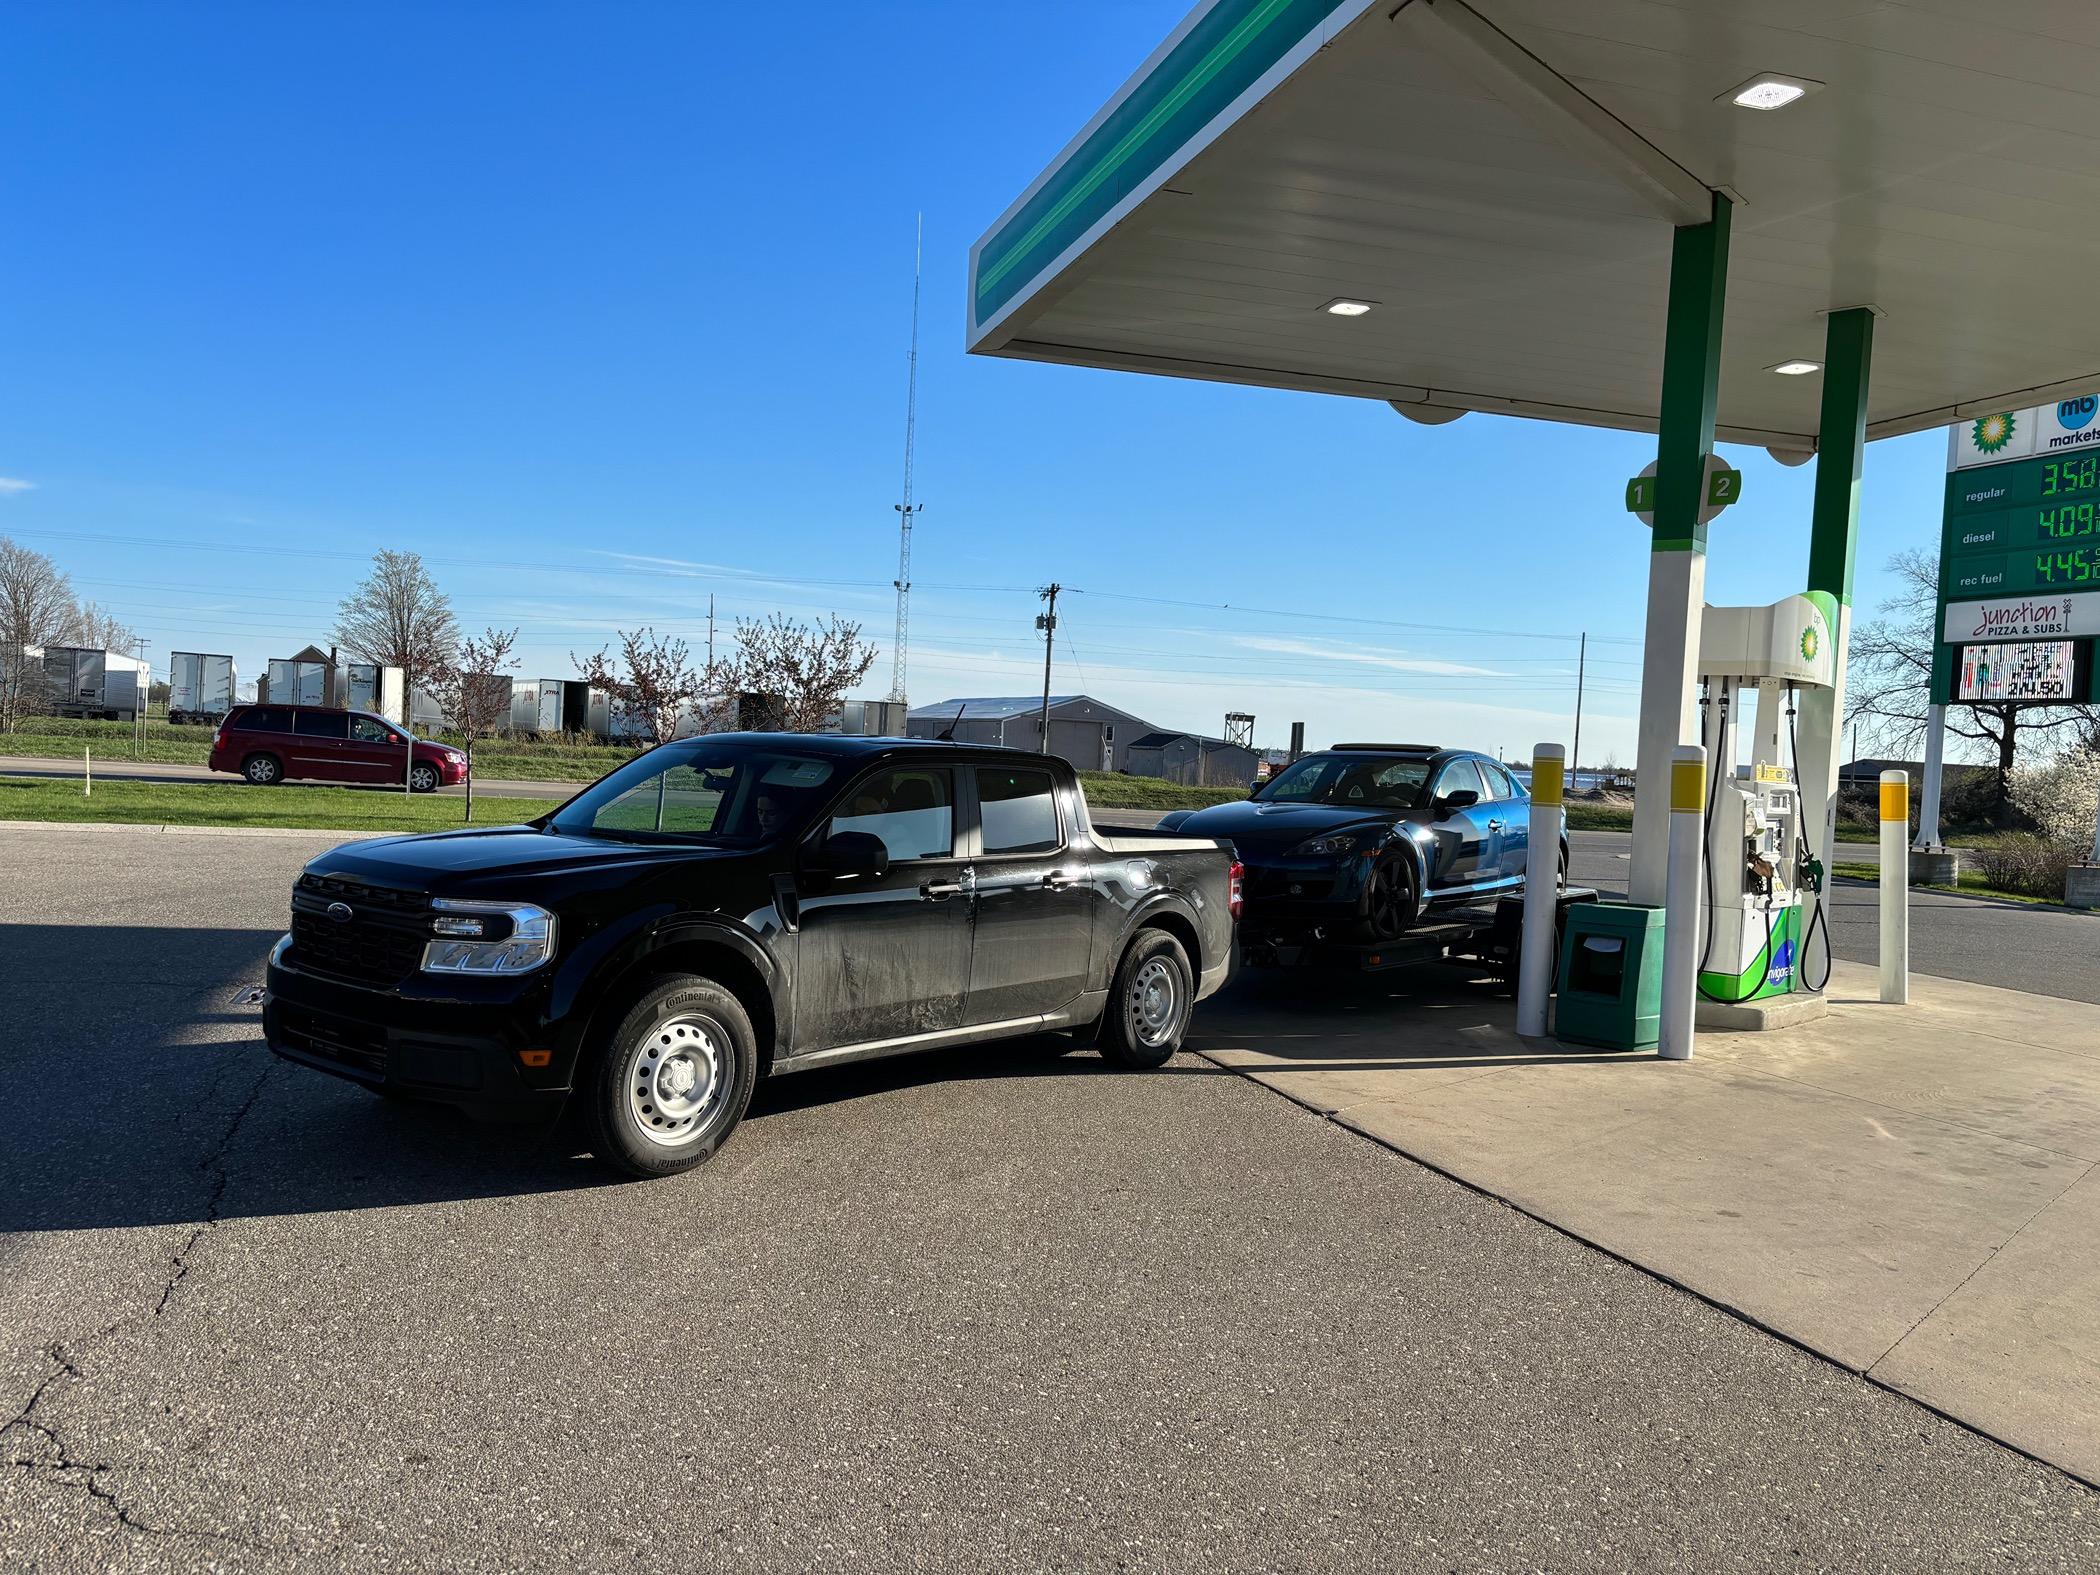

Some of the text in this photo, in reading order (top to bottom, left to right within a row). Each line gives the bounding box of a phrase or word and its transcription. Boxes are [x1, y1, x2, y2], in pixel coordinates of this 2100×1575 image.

[2049, 428, 2100, 447] markets
[1716, 477, 1731, 497] 2
[1966, 457, 2096, 502] regular 3.58
[1634, 484, 1644, 504] 1
[1962, 530, 1995, 544] diesel
[2039, 503, 2093, 537] 4.09
[1960, 549, 2090, 586] rec fuel 4.45
[1972, 602, 2057, 637] junction
[1987, 622, 2063, 636] PIZZA & SUBS
[665, 991, 714, 1009] Continental
